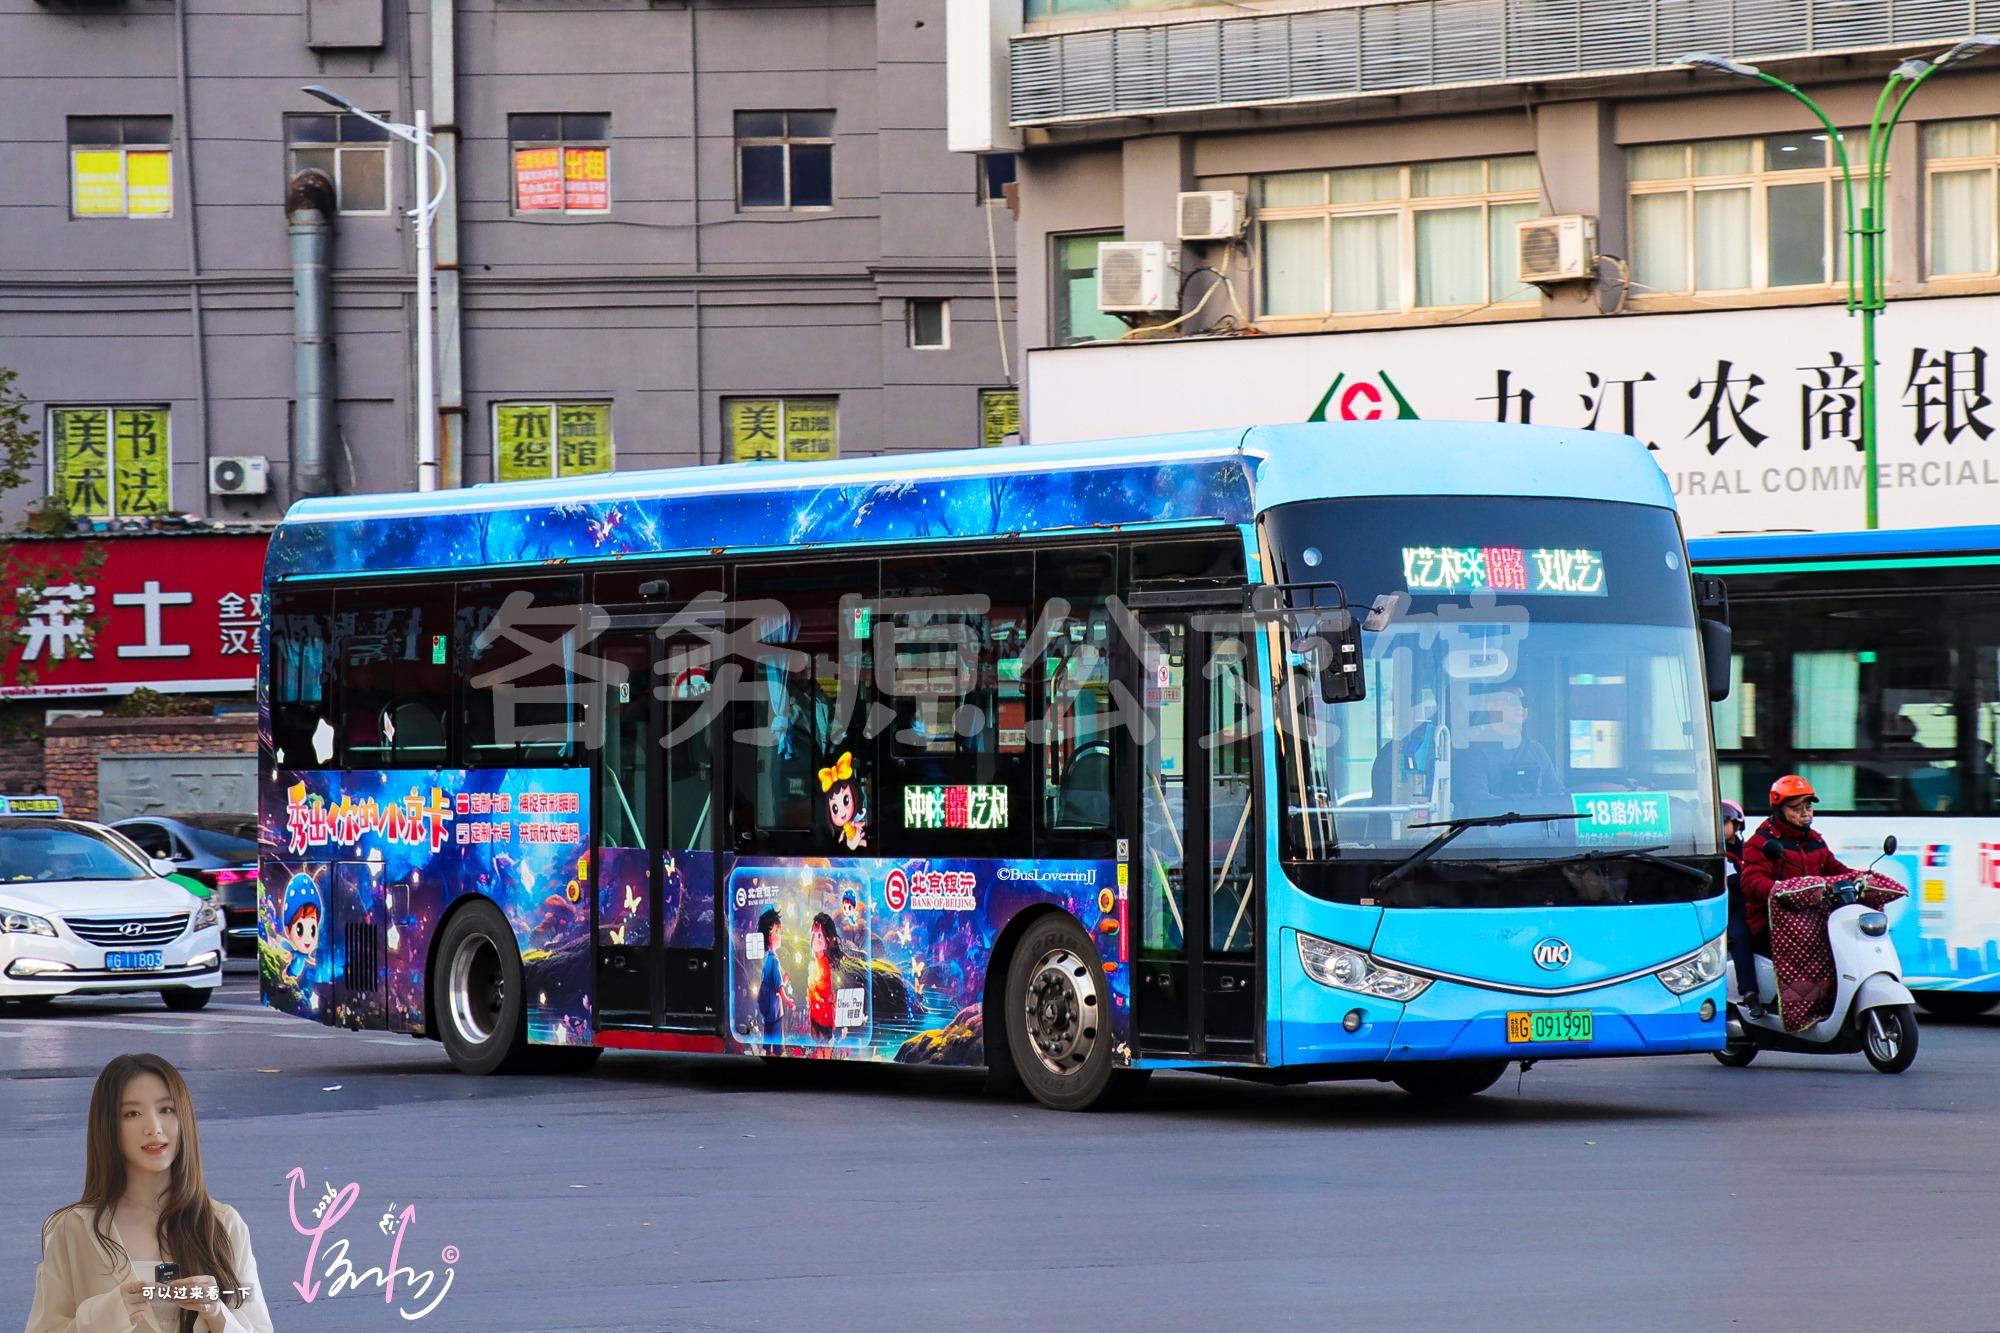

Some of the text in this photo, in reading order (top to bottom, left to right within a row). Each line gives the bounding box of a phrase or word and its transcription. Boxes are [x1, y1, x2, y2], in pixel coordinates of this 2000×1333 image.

[564, 151, 605, 179] 出租
[1475, 346, 1998, 456] 九江农商银
[68, 411, 107, 513] 美术
[118, 412, 158, 512] 书法
[1762, 459, 2000, 494] COMMERCIAL
[470, 793, 579, 814] 定制卡面 捕捉京彩瞬间
[1586, 800, 1658, 825] 18路外环
[286, 780, 454, 856] 秀出你的小京卡
[470, 822, 579, 844] 定制卡号 共筑成长密码
[910, 871, 976, 897] 北京银行
[912, 897, 975, 910] BANK OF BEIJING
